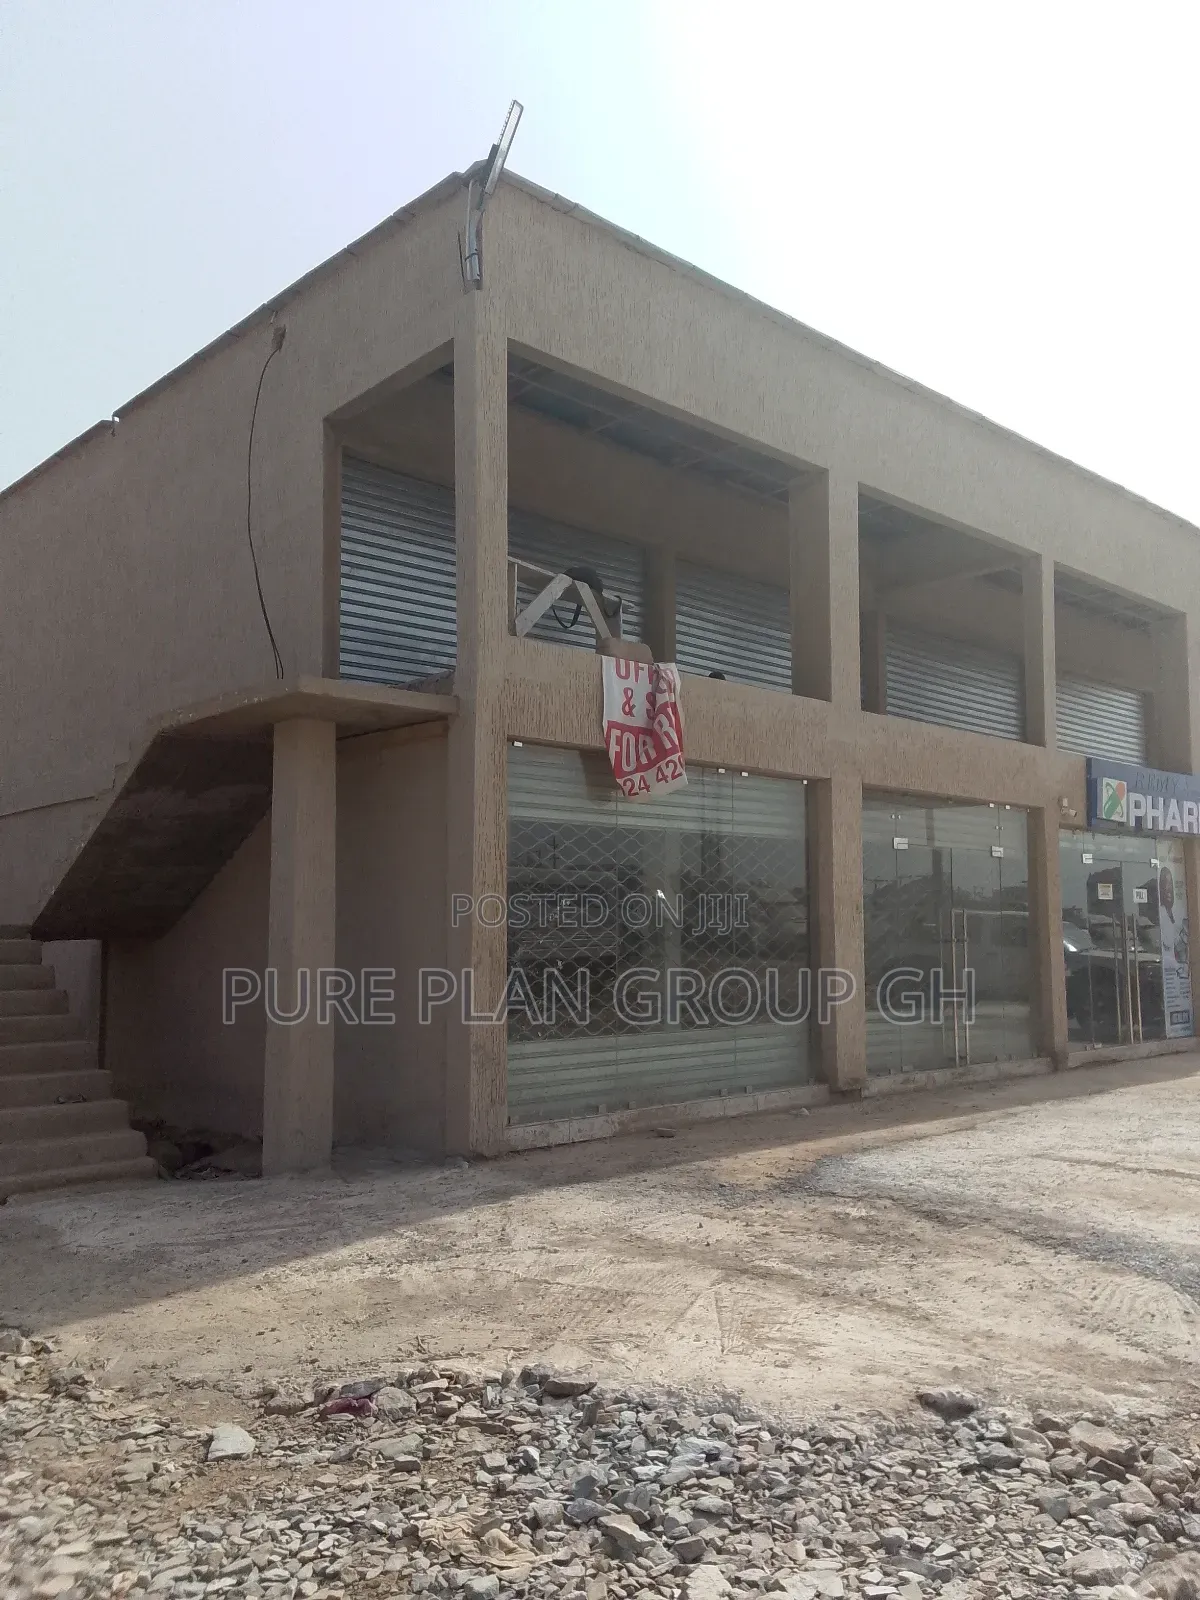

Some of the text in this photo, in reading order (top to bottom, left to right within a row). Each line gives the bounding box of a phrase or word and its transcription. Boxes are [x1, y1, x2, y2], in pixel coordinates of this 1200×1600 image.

[622, 687, 637, 718] &
[609, 728, 657, 771] FOR
[618, 775, 651, 797] 24
[1129, 792, 1200, 834] PHAR
